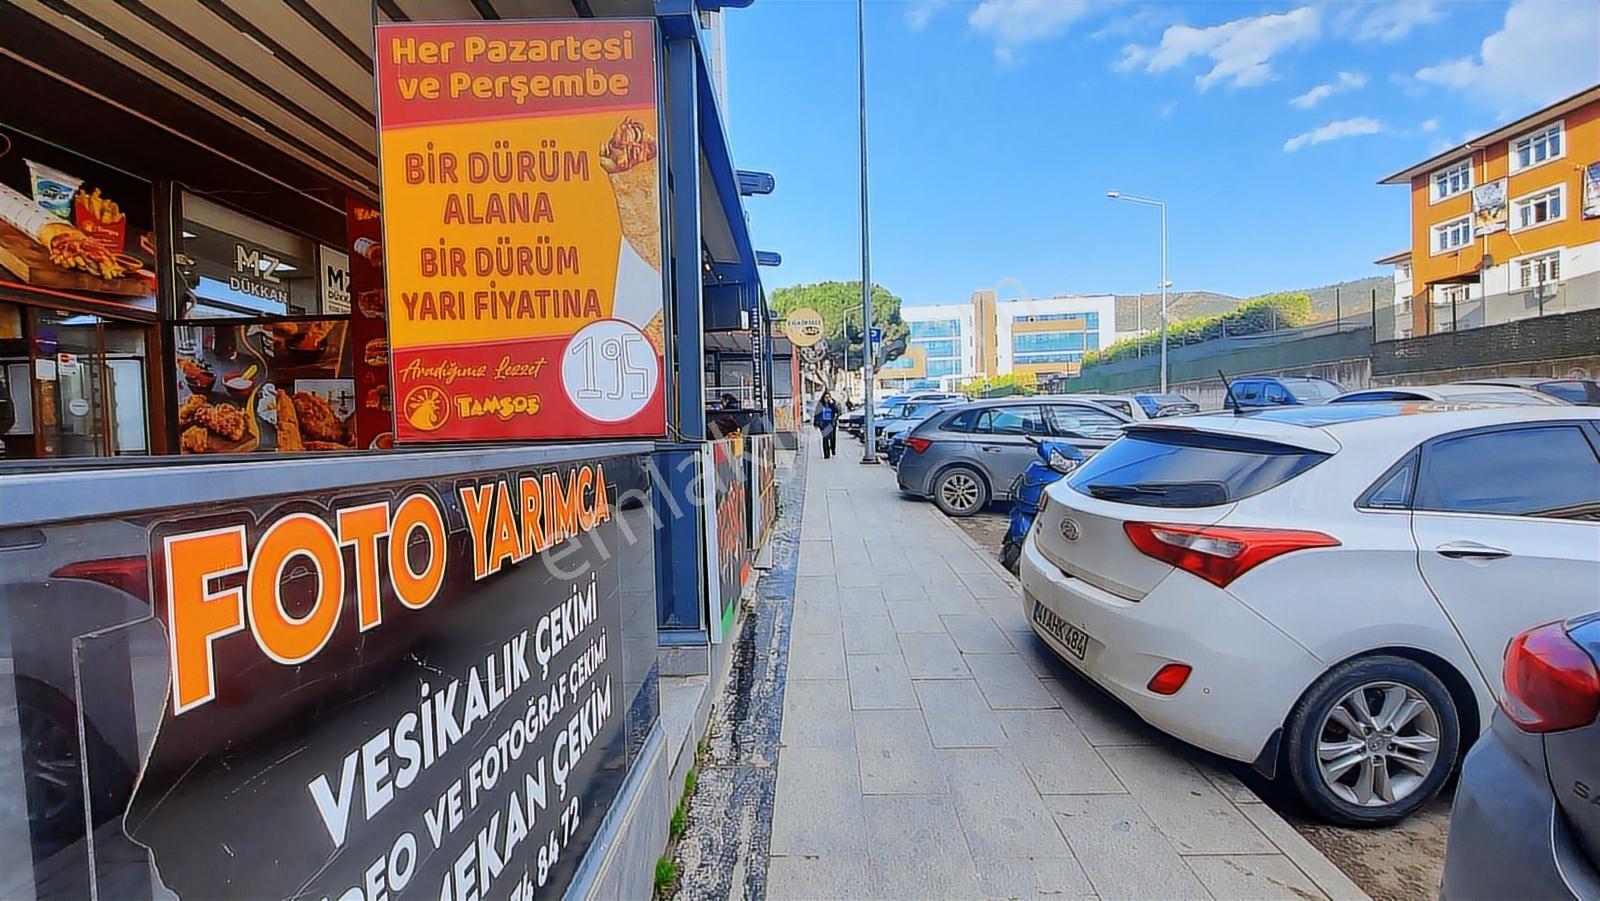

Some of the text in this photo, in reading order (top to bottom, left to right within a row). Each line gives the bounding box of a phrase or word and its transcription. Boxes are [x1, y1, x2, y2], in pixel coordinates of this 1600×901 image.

[392, 30, 633, 64] Her Pazartesi
[399, 67, 629, 105] ve Perşembe
[405, 140, 590, 184] BİR DÜRÜM
[444, 192, 554, 225] ALANA
[234, 243, 280, 284] MZ
[420, 236, 579, 277] BİR DÜRÜM
[229, 276, 288, 304] DÜKKAN
[402, 281, 602, 321] YARI FİYATINA
[494, 355, 548, 380] Lezzet
[572, 333, 649, 400] 195
[456, 392, 542, 419] TAMSOS
[163, 493, 448, 717] FOTO
[459, 463, 612, 581] YARIMCA
[1065, 626, 1084, 655] 484
[308, 571, 598, 849] VESİKALIK ÇEKİMİ
[423, 779, 464, 851] VE
[469, 673, 567, 809] FOTOĞRAF
[569, 626, 608, 704] ÇEKİMİ
[552, 674, 613, 802] ÇEKİM
[538, 830, 559, 887] 84
[561, 796, 580, 848] 72
